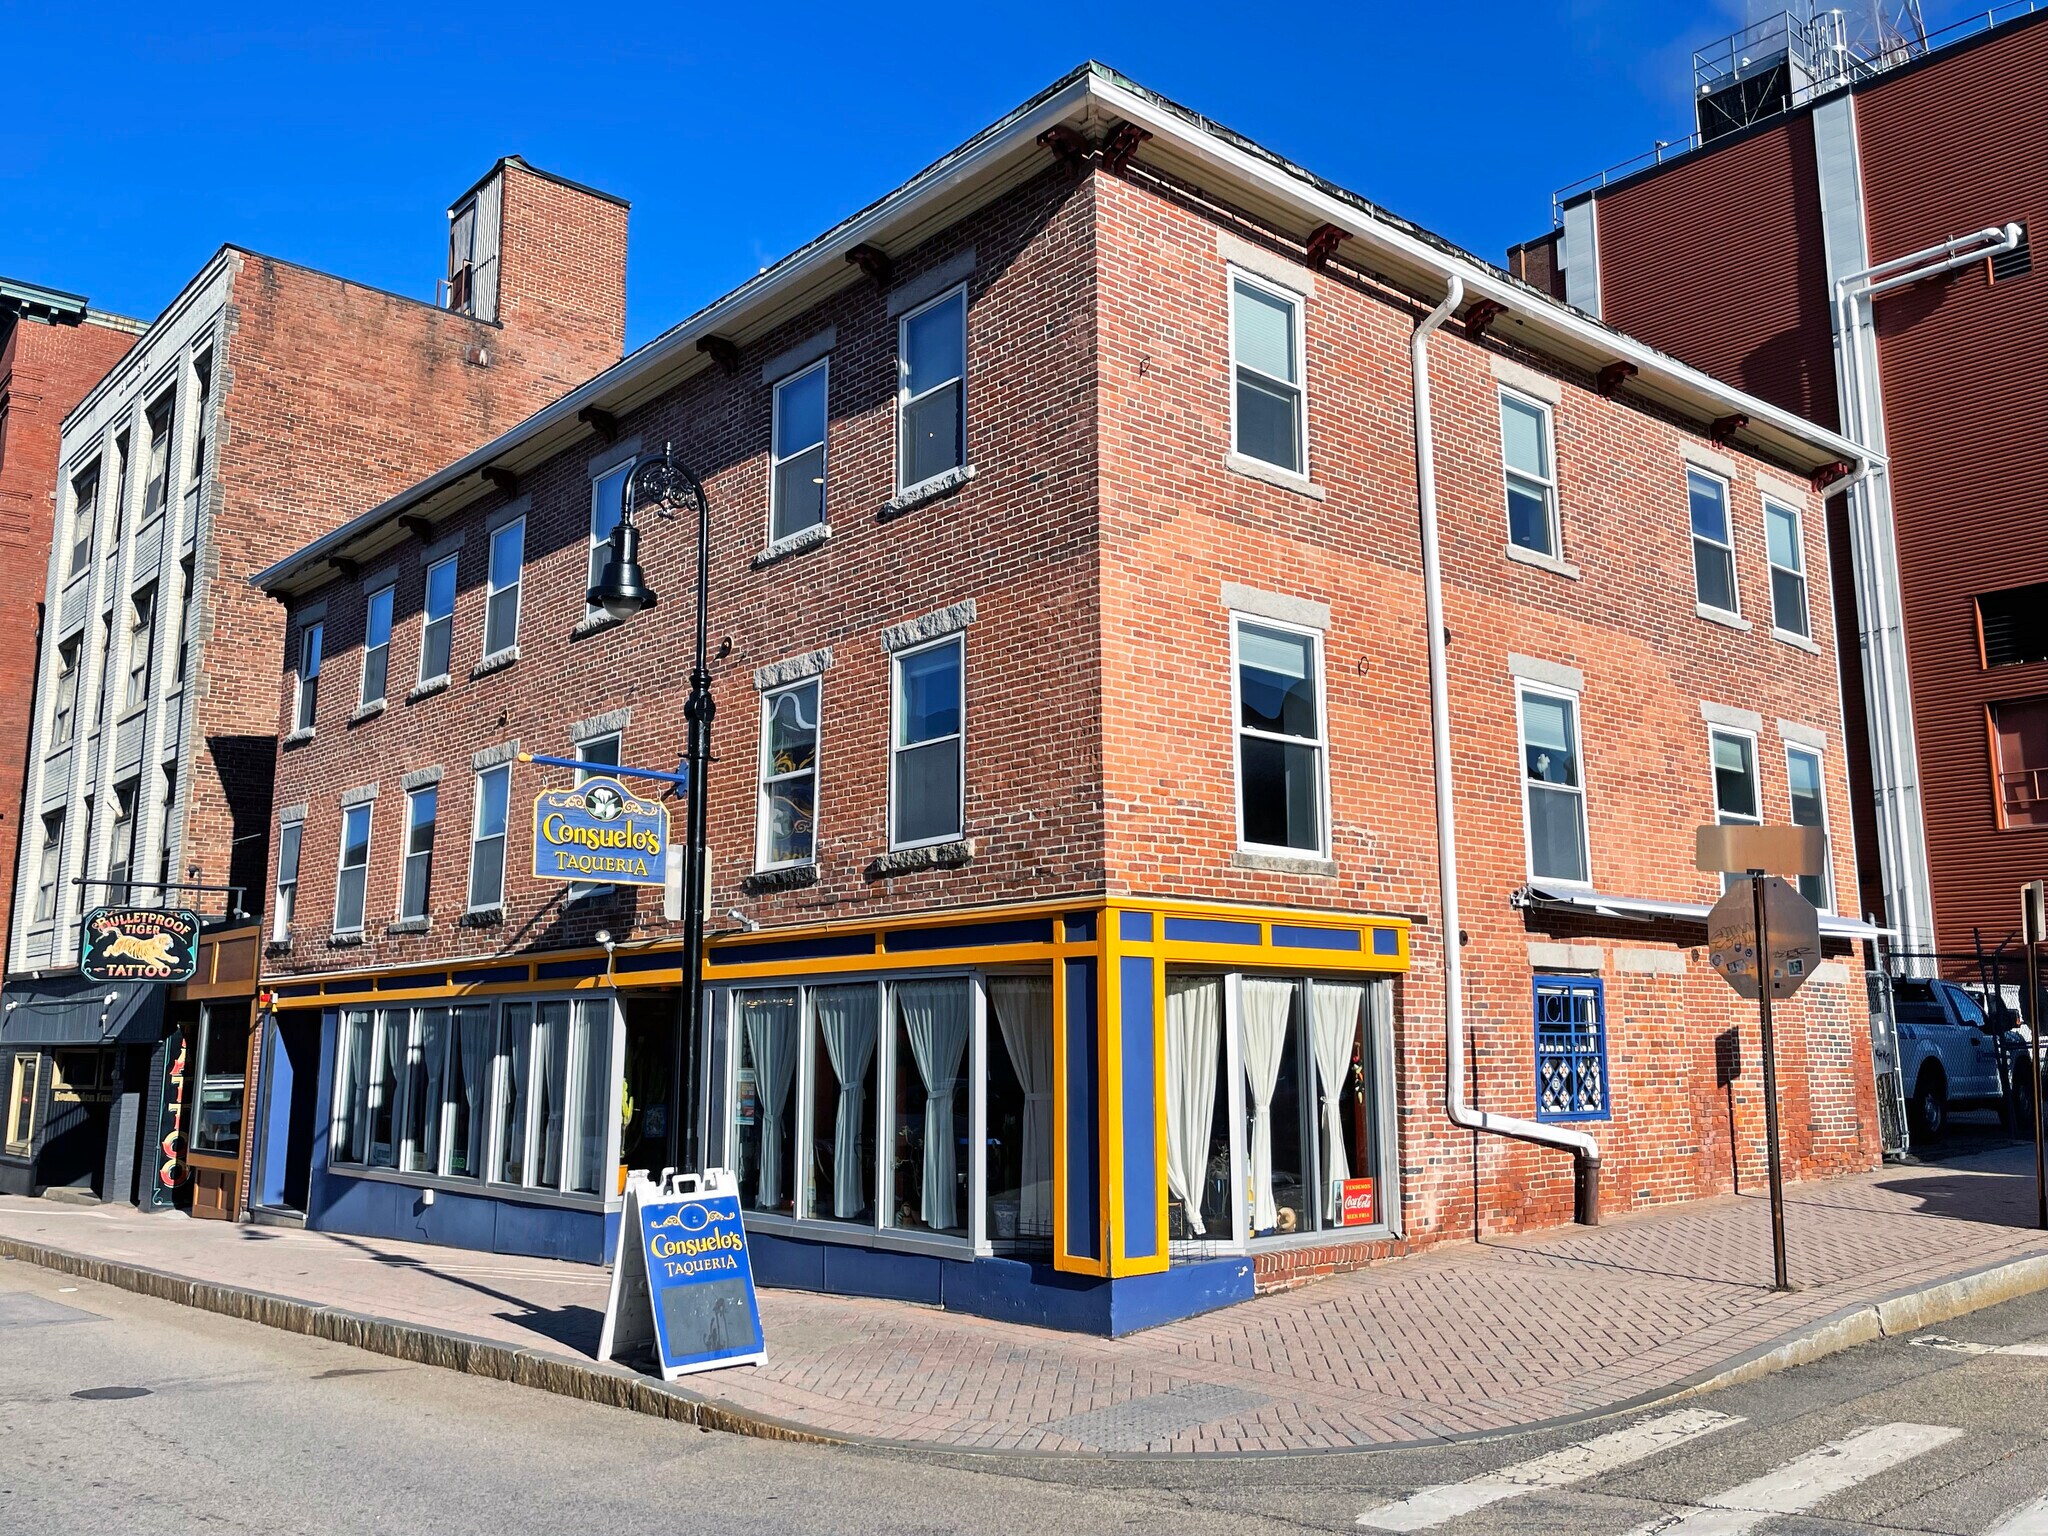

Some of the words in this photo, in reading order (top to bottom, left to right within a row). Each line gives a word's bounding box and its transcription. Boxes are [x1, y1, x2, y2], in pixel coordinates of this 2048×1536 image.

[542, 813, 661, 855] Consuelo's
[554, 851, 649, 877] TAQUERIA
[95, 912, 192, 935] BULLETPROOF
[124, 924, 160, 935] TIGER
[106, 964, 171, 977] TATTOO
[651, 1226, 744, 1259] Consuelo's
[664, 1254, 738, 1278] TAQUERIA
